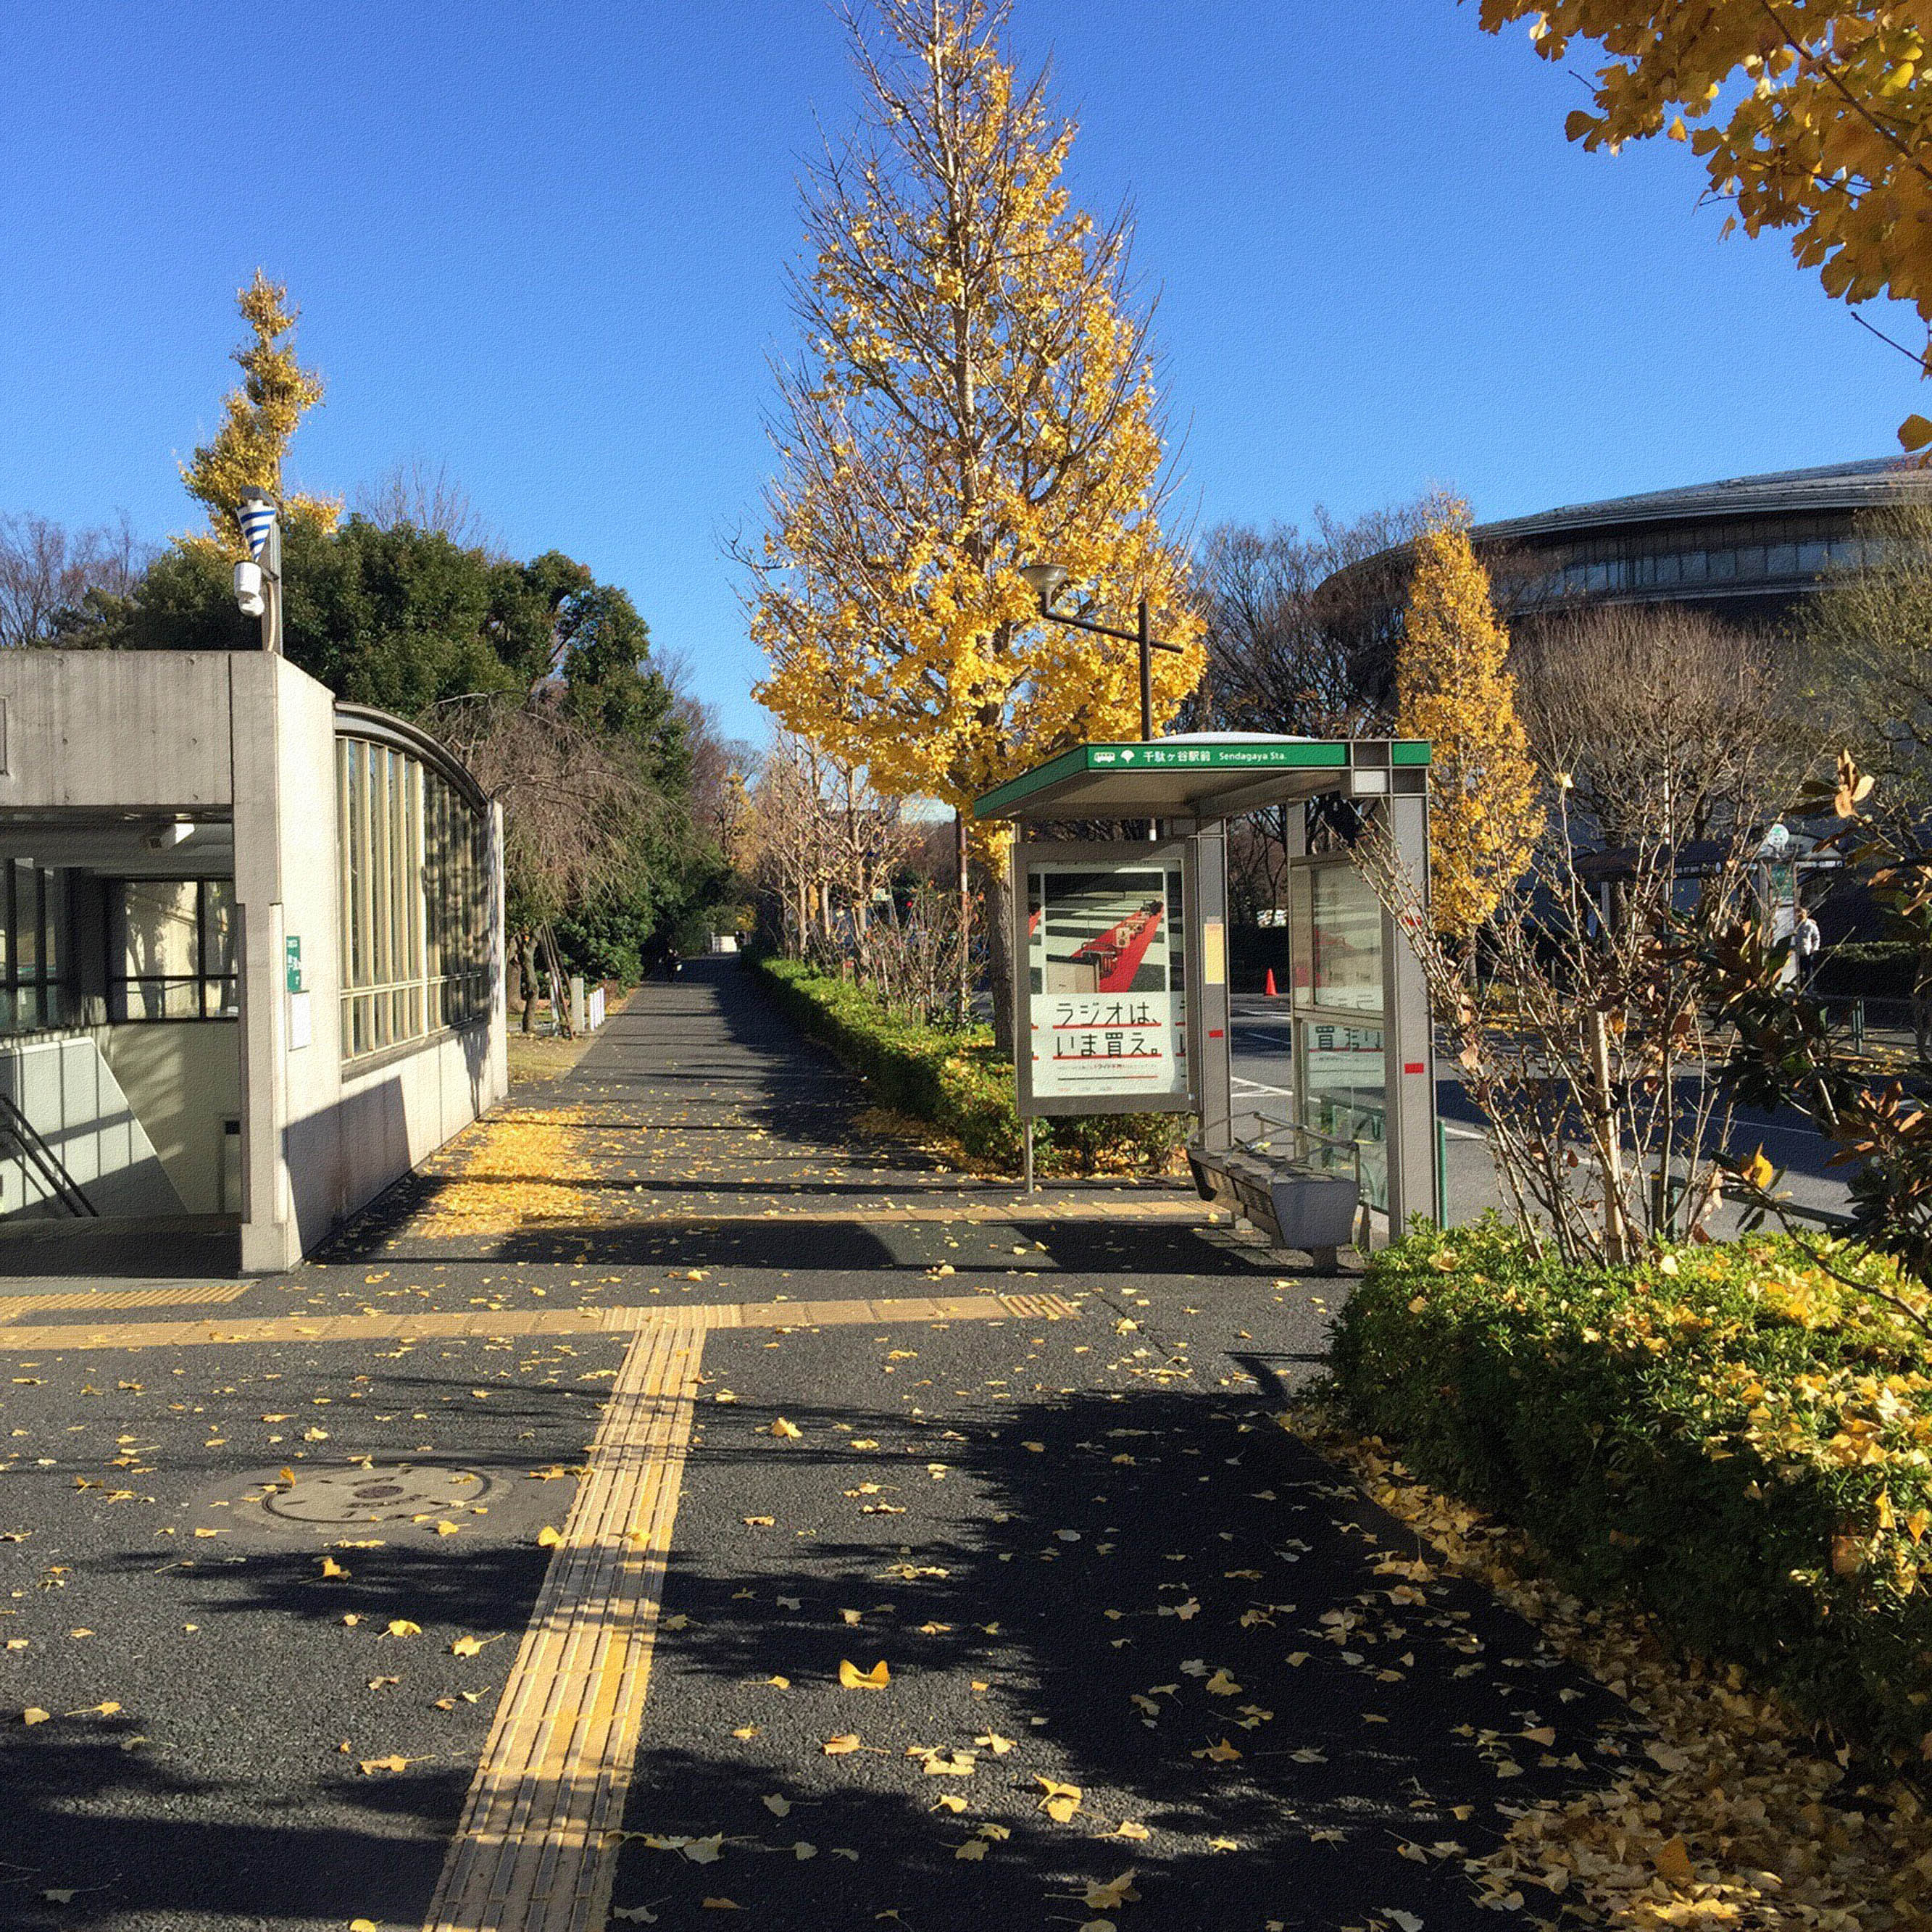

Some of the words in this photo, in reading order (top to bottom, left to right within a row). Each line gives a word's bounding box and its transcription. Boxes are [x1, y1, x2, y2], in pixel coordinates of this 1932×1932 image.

[1218, 751, 1268, 762] Sendagaya
[1270, 751, 1287, 760] Sta.
[1057, 1002, 1157, 1025] ラジオは、
[1057, 1032, 1159, 1057] いま買え。
